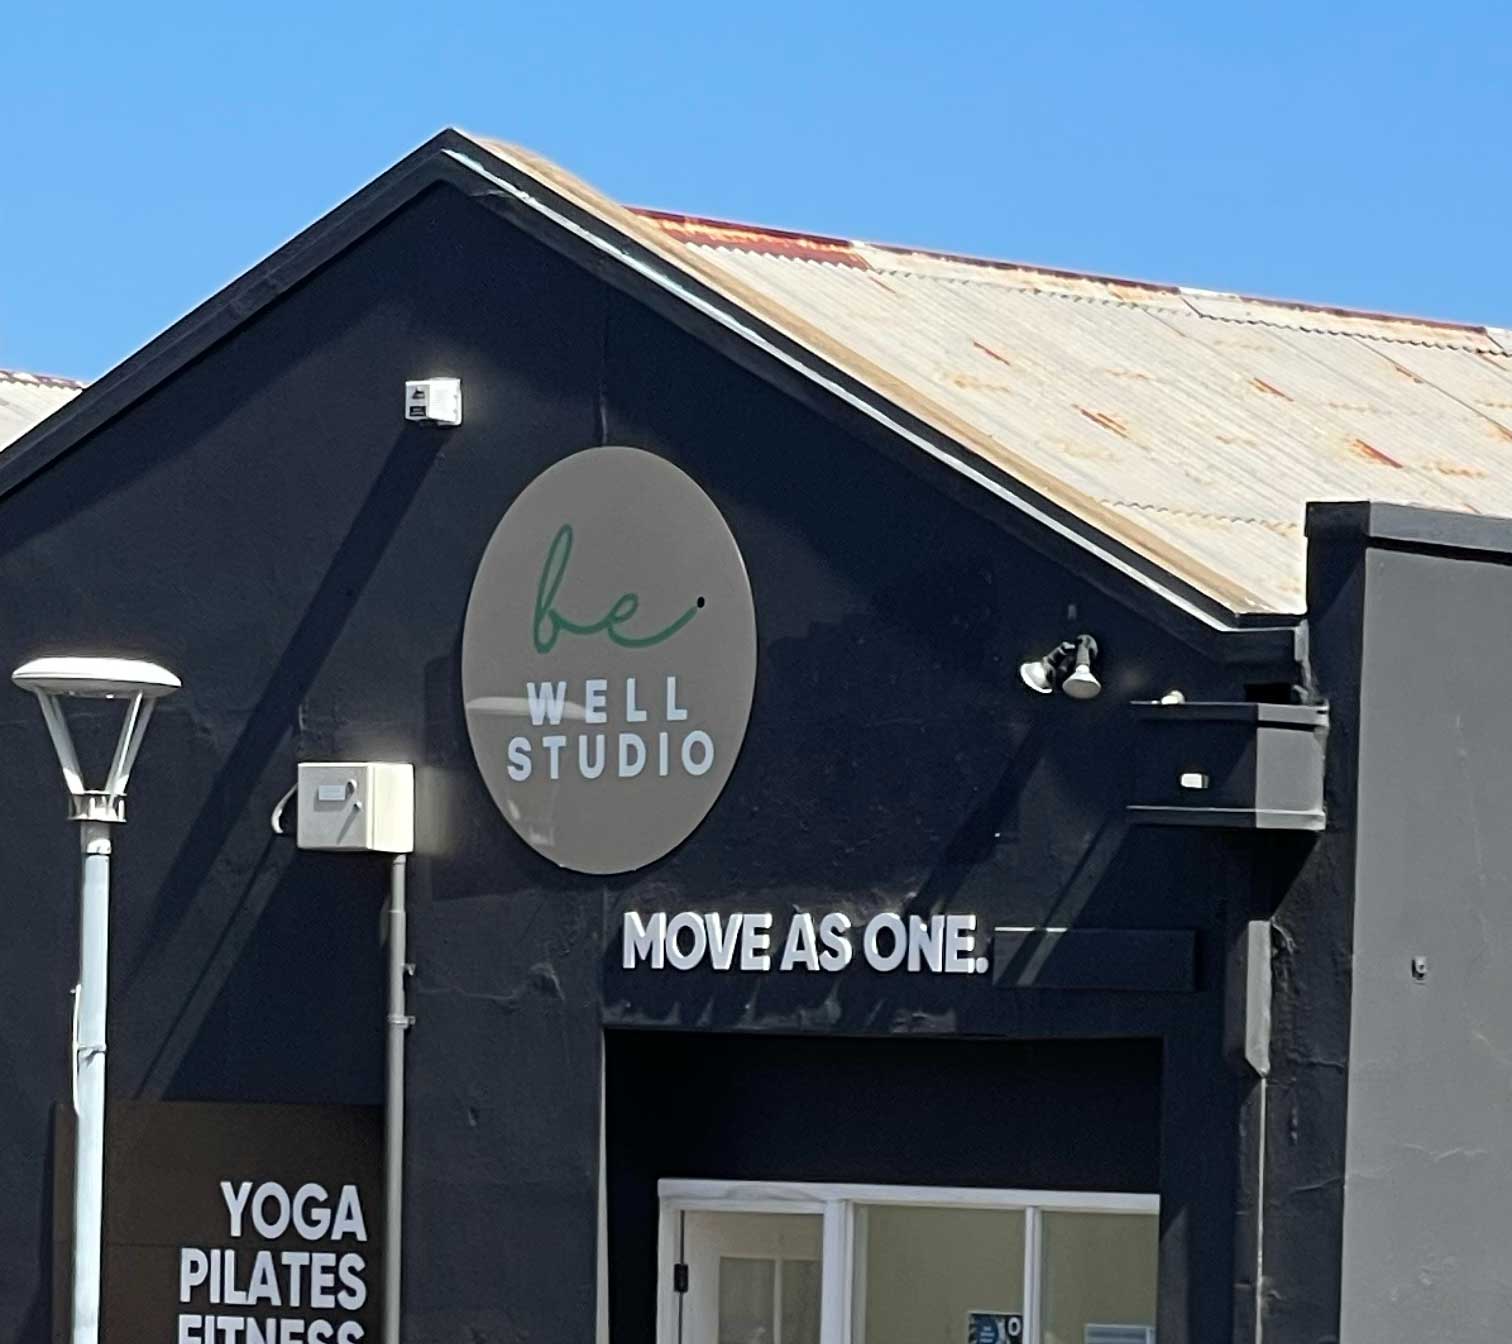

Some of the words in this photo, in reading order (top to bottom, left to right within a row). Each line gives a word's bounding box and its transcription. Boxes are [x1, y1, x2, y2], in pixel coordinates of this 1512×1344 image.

[526, 675, 688, 725] WELL
[507, 729, 715, 781] STUDIO
[622, 911, 773, 971] MOVE
[780, 912, 853, 973] AS
[863, 912, 989, 975] ONE.
[219, 1180, 368, 1242] YOGA
[179, 1247, 367, 1311] PILATES
